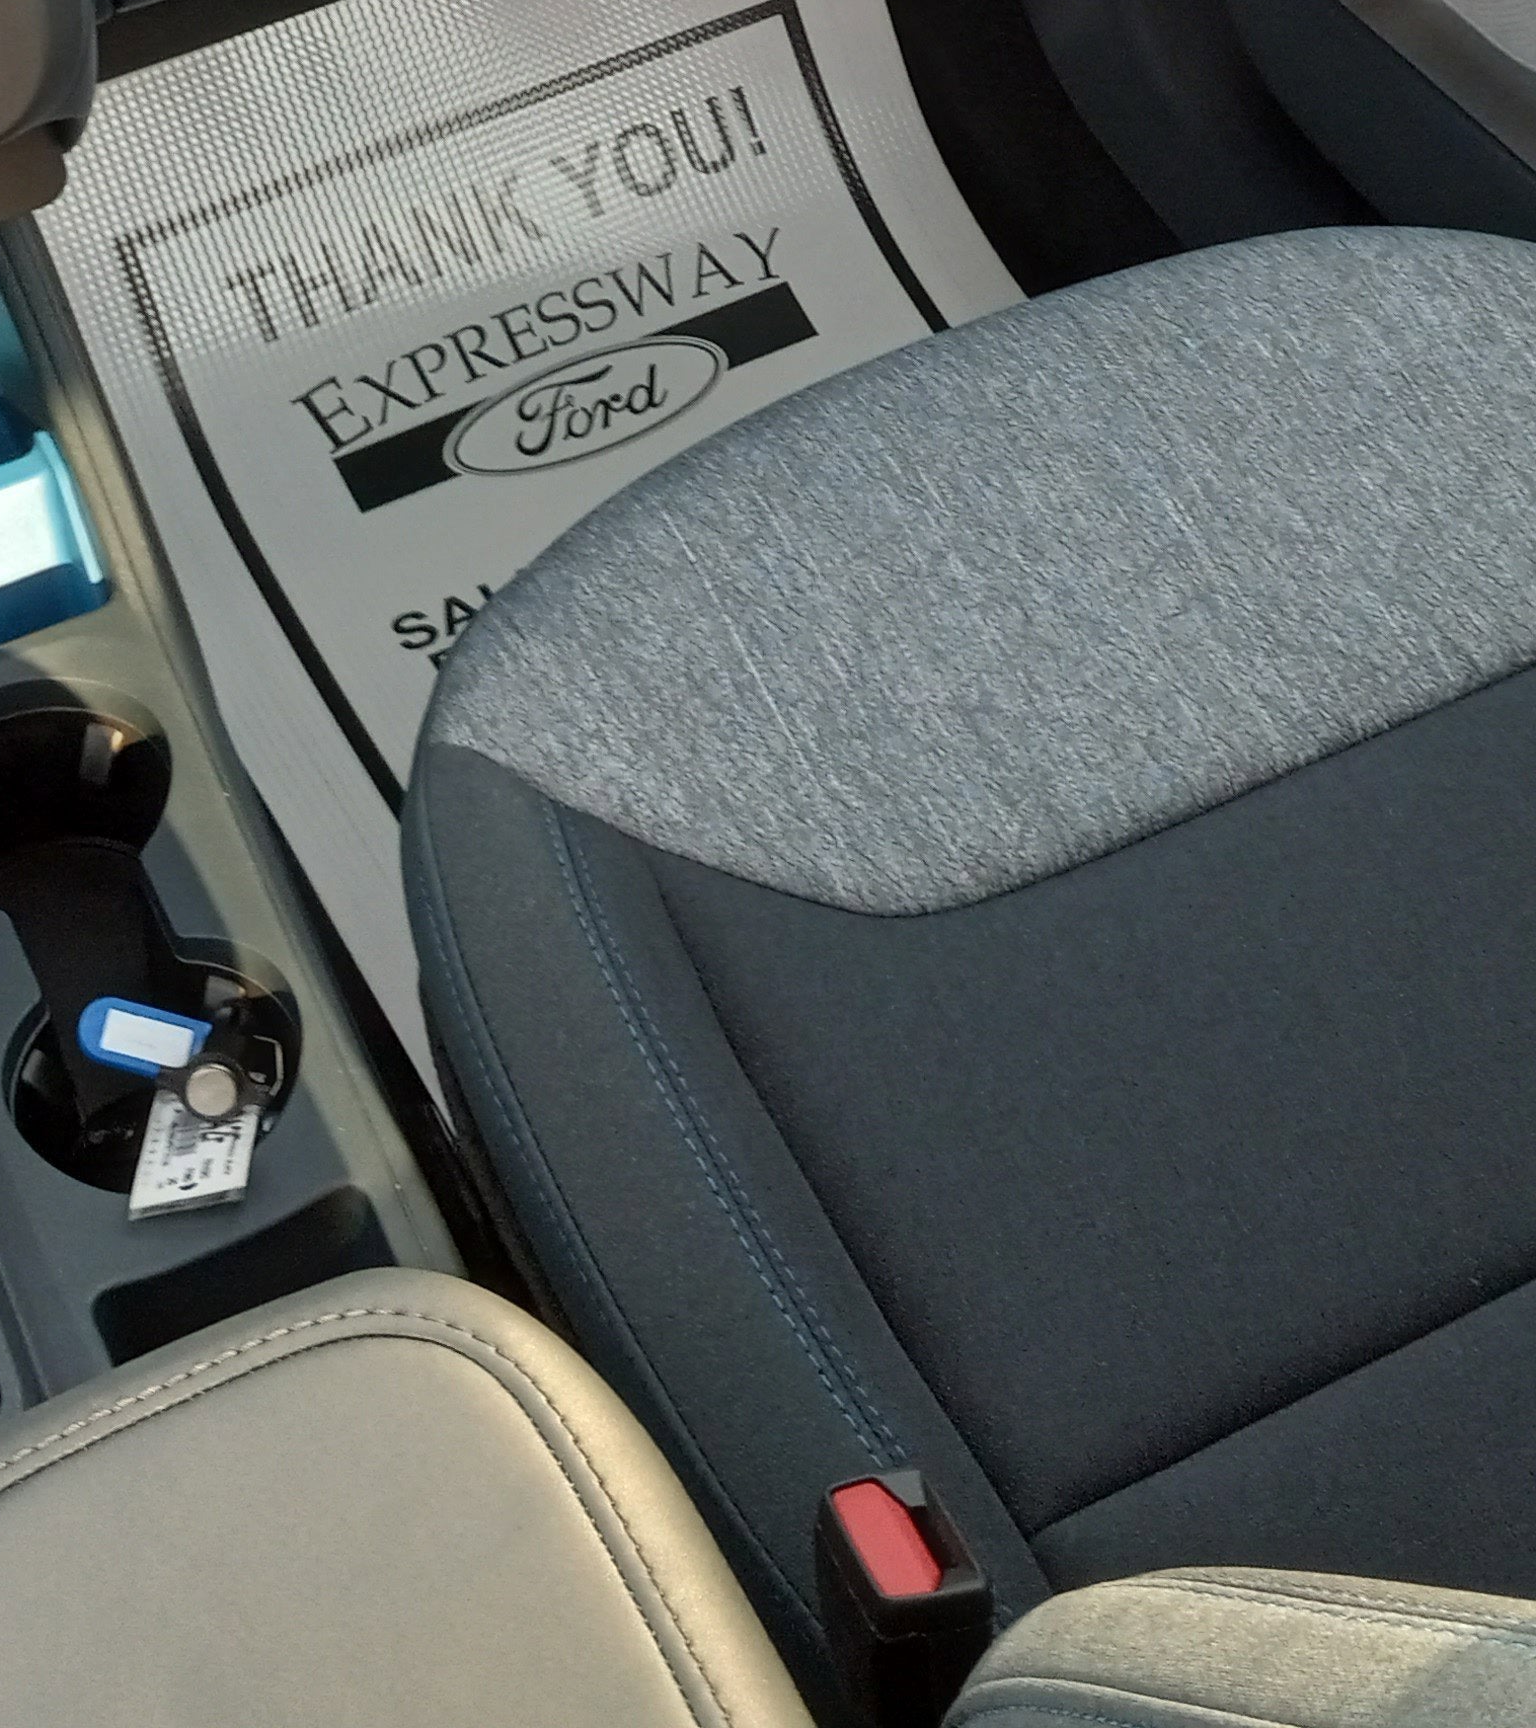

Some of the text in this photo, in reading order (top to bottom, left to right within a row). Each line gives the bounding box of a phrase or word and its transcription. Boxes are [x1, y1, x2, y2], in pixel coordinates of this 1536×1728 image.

[228, 86, 768, 344] THANK YOU!
[290, 228, 780, 454] EXPRESSWAY
[514, 364, 667, 457] Ford
